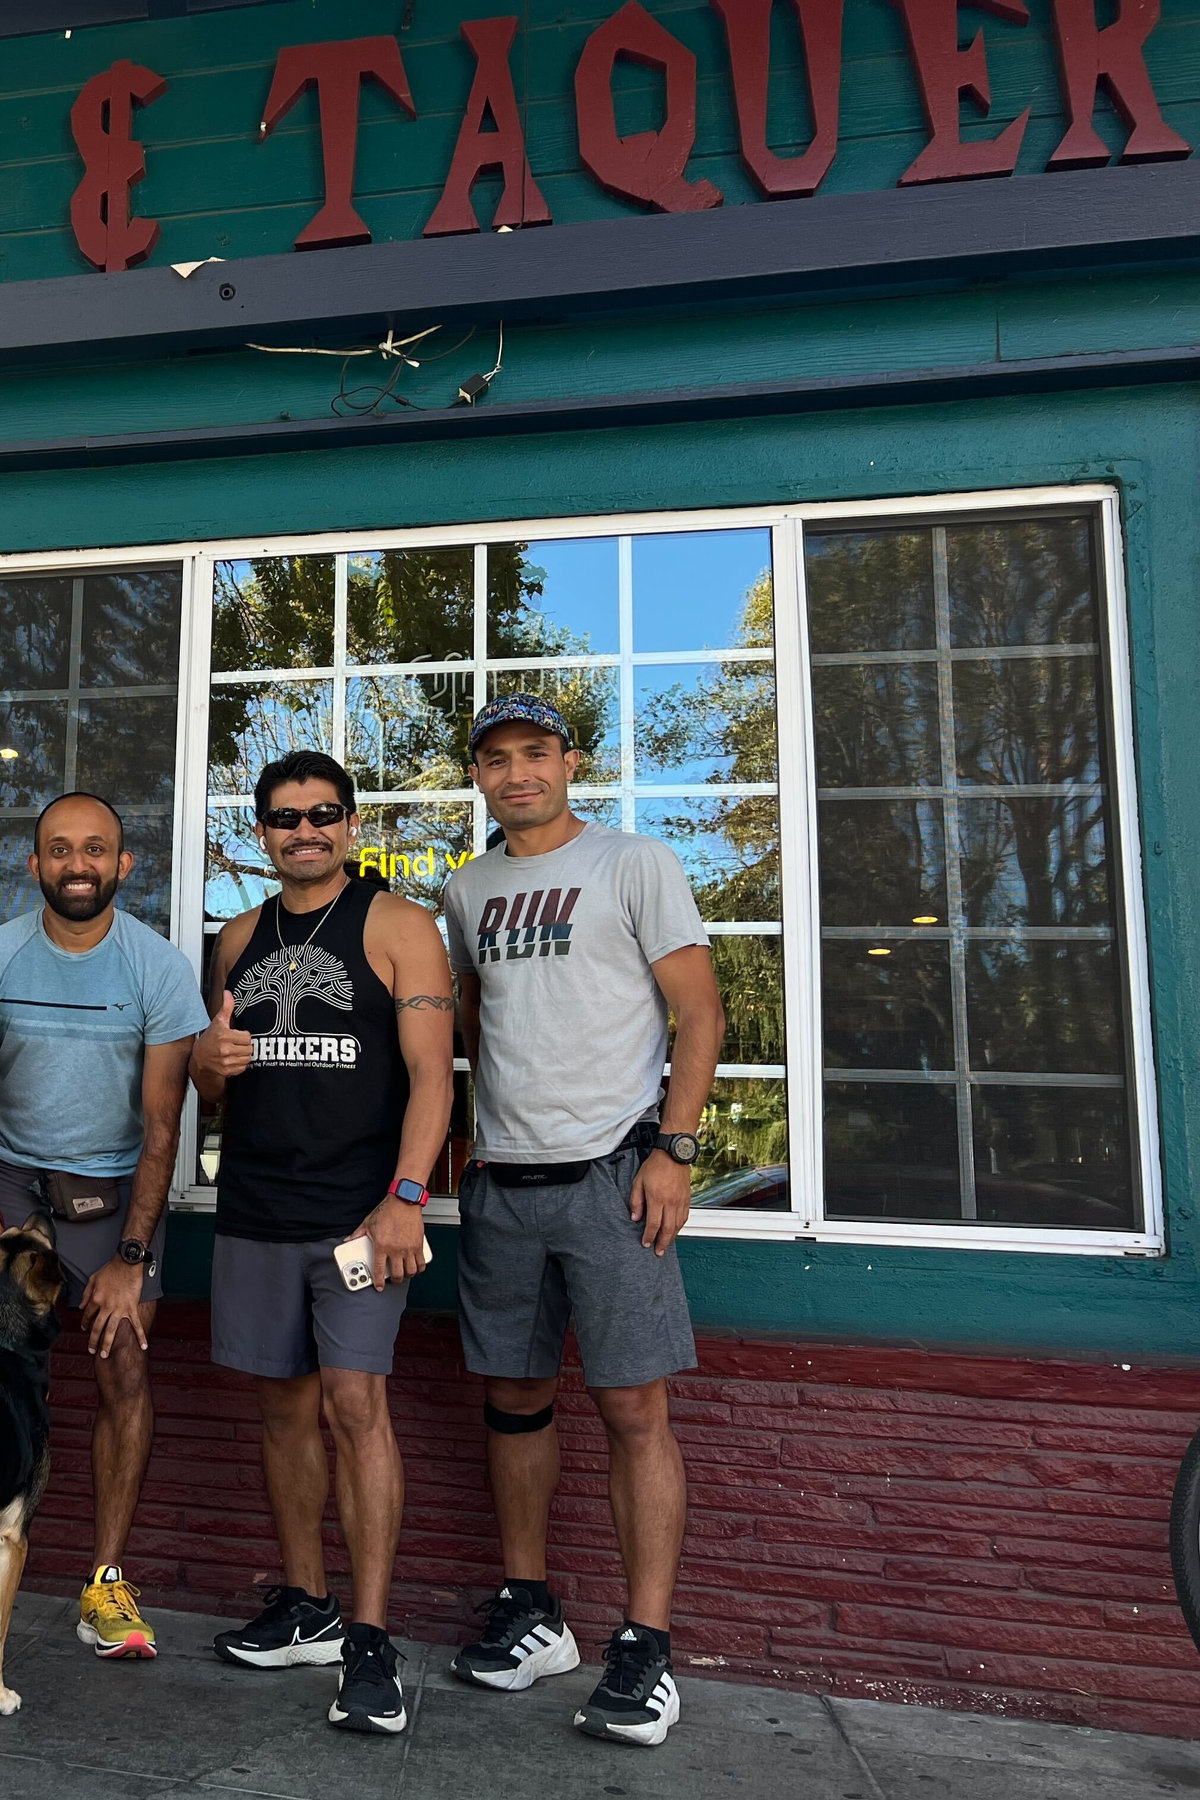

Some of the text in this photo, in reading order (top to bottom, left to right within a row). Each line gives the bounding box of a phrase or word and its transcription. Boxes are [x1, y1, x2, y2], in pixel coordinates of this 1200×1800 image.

[359, 847, 434, 878] Find
[477, 887, 582, 965] RUN
[311, 1061, 335, 1069] Outdoor
